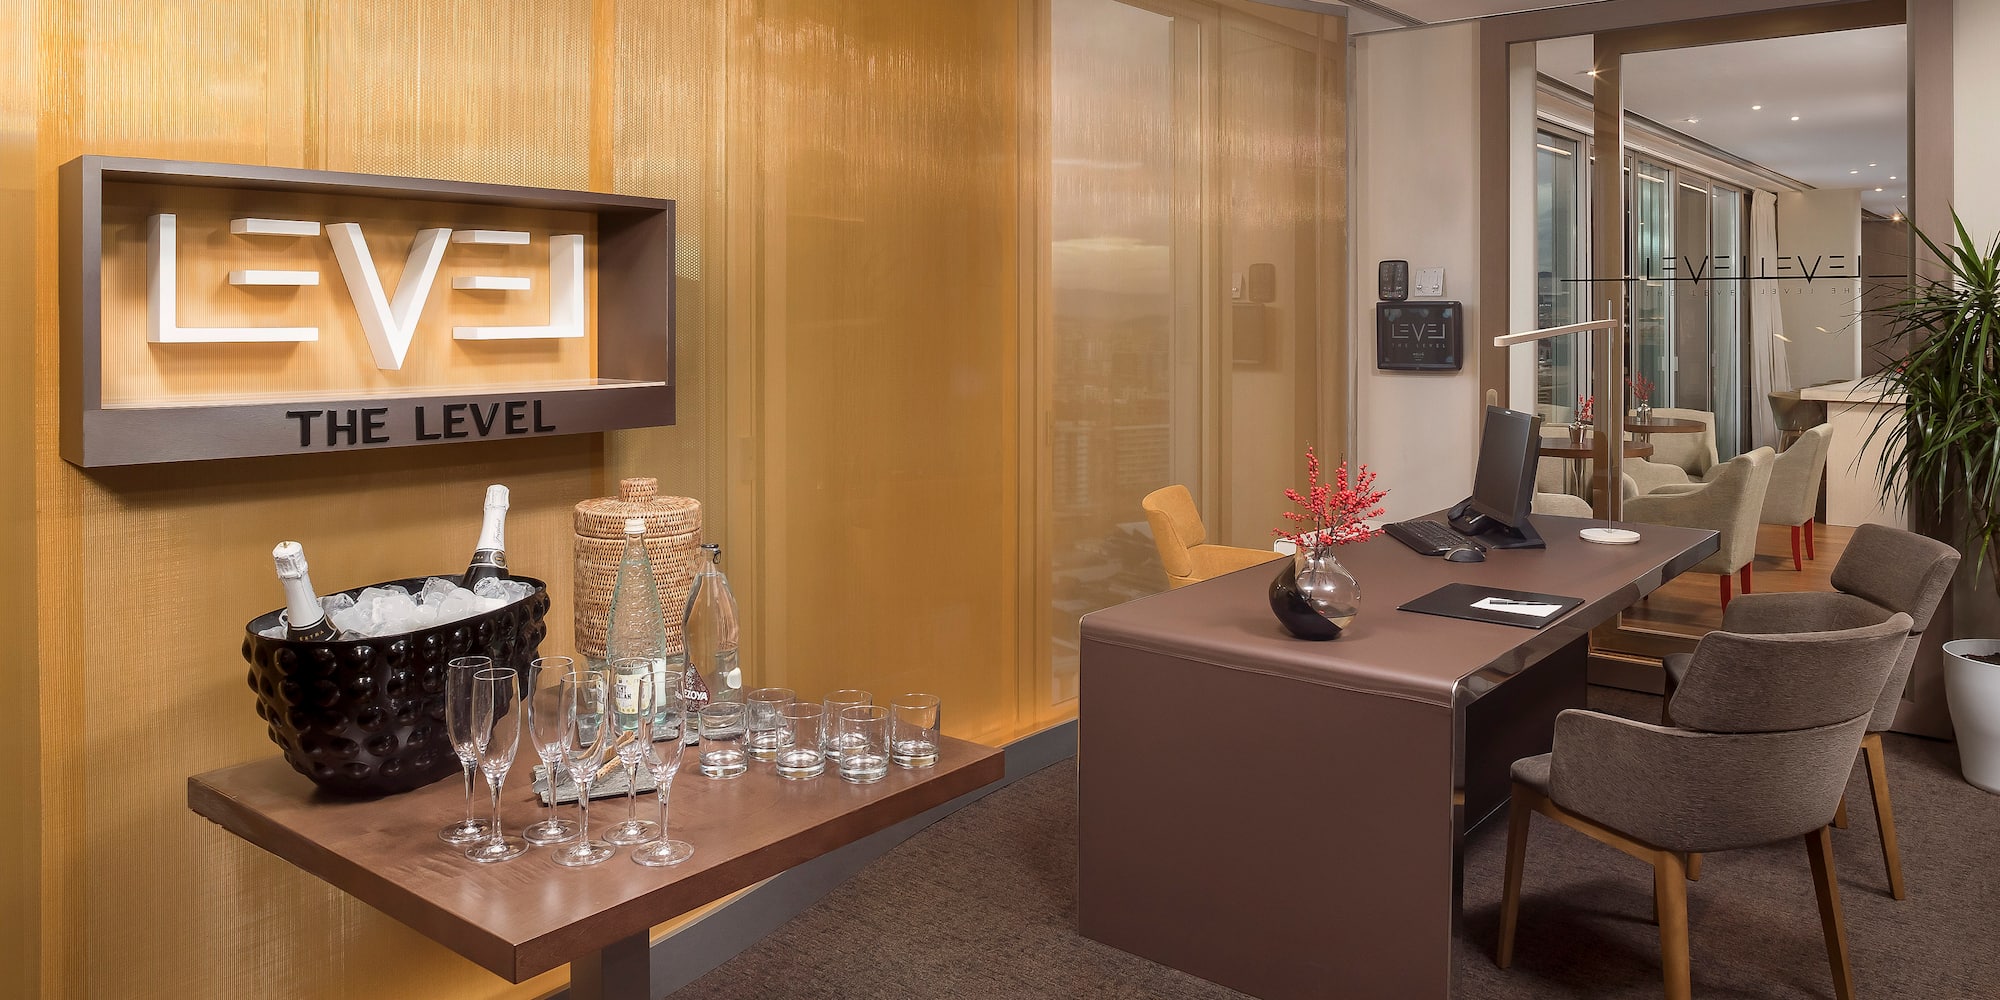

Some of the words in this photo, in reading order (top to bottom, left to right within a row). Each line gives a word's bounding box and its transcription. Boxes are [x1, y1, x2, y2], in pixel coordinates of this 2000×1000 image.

[147, 213, 585, 371] LEVEL
[1392, 323, 1445, 341] LEVEL
[286, 408, 390, 447] THE
[414, 400, 556, 441] LEVEL
[675, 689, 708, 701] EZOYA
